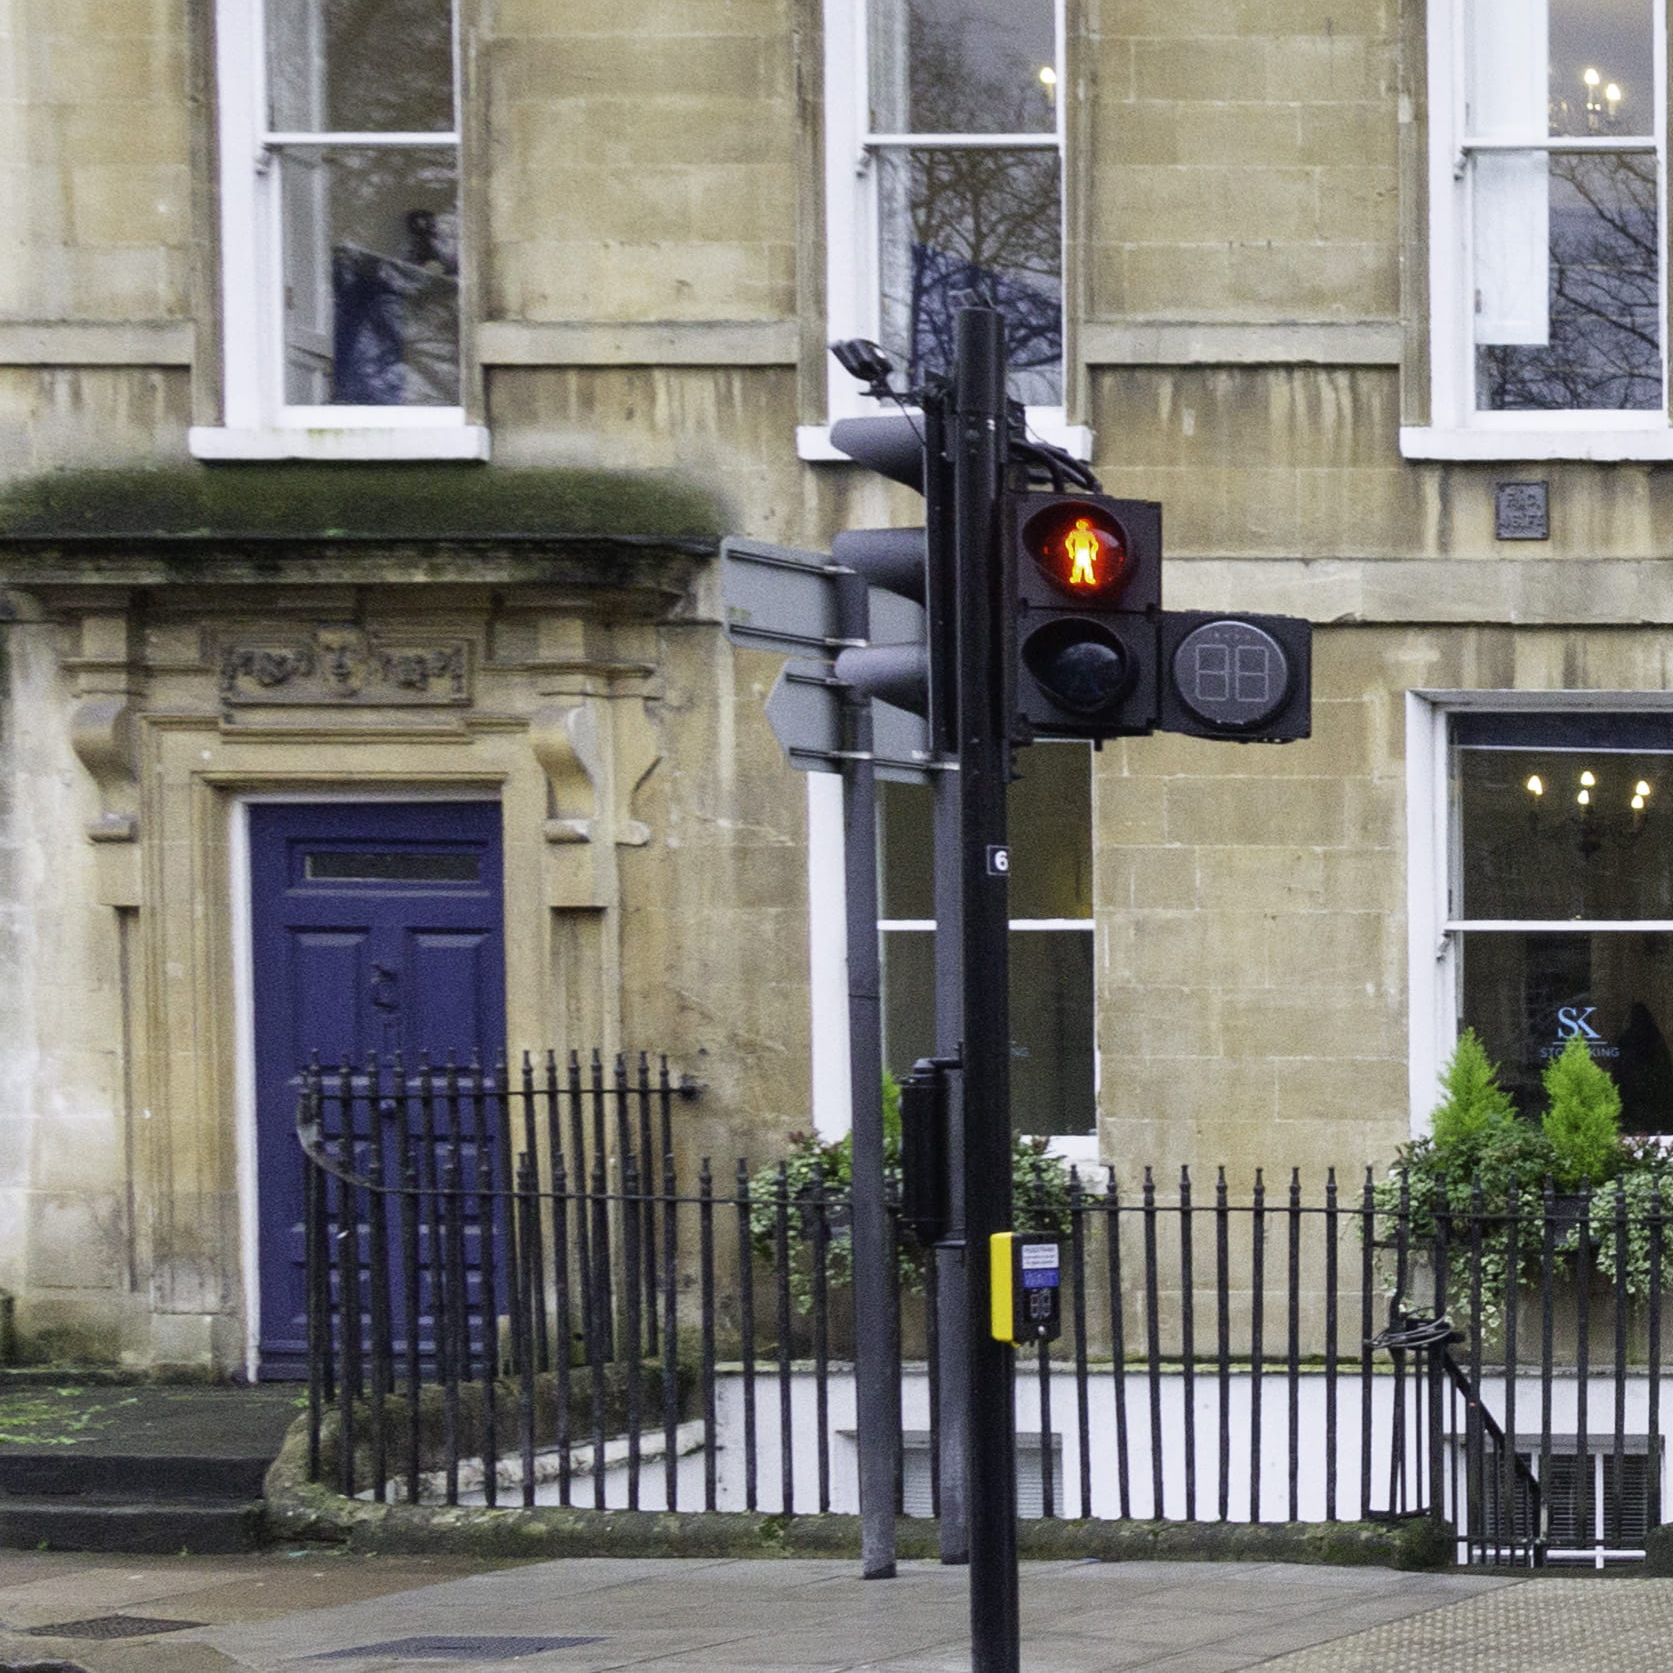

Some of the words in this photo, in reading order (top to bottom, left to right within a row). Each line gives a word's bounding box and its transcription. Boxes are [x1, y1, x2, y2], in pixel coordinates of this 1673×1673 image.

[994, 850, 1009, 871] 6
[1557, 1006, 1602, 1039] SK
[1589, 1046, 1620, 1058] KING
